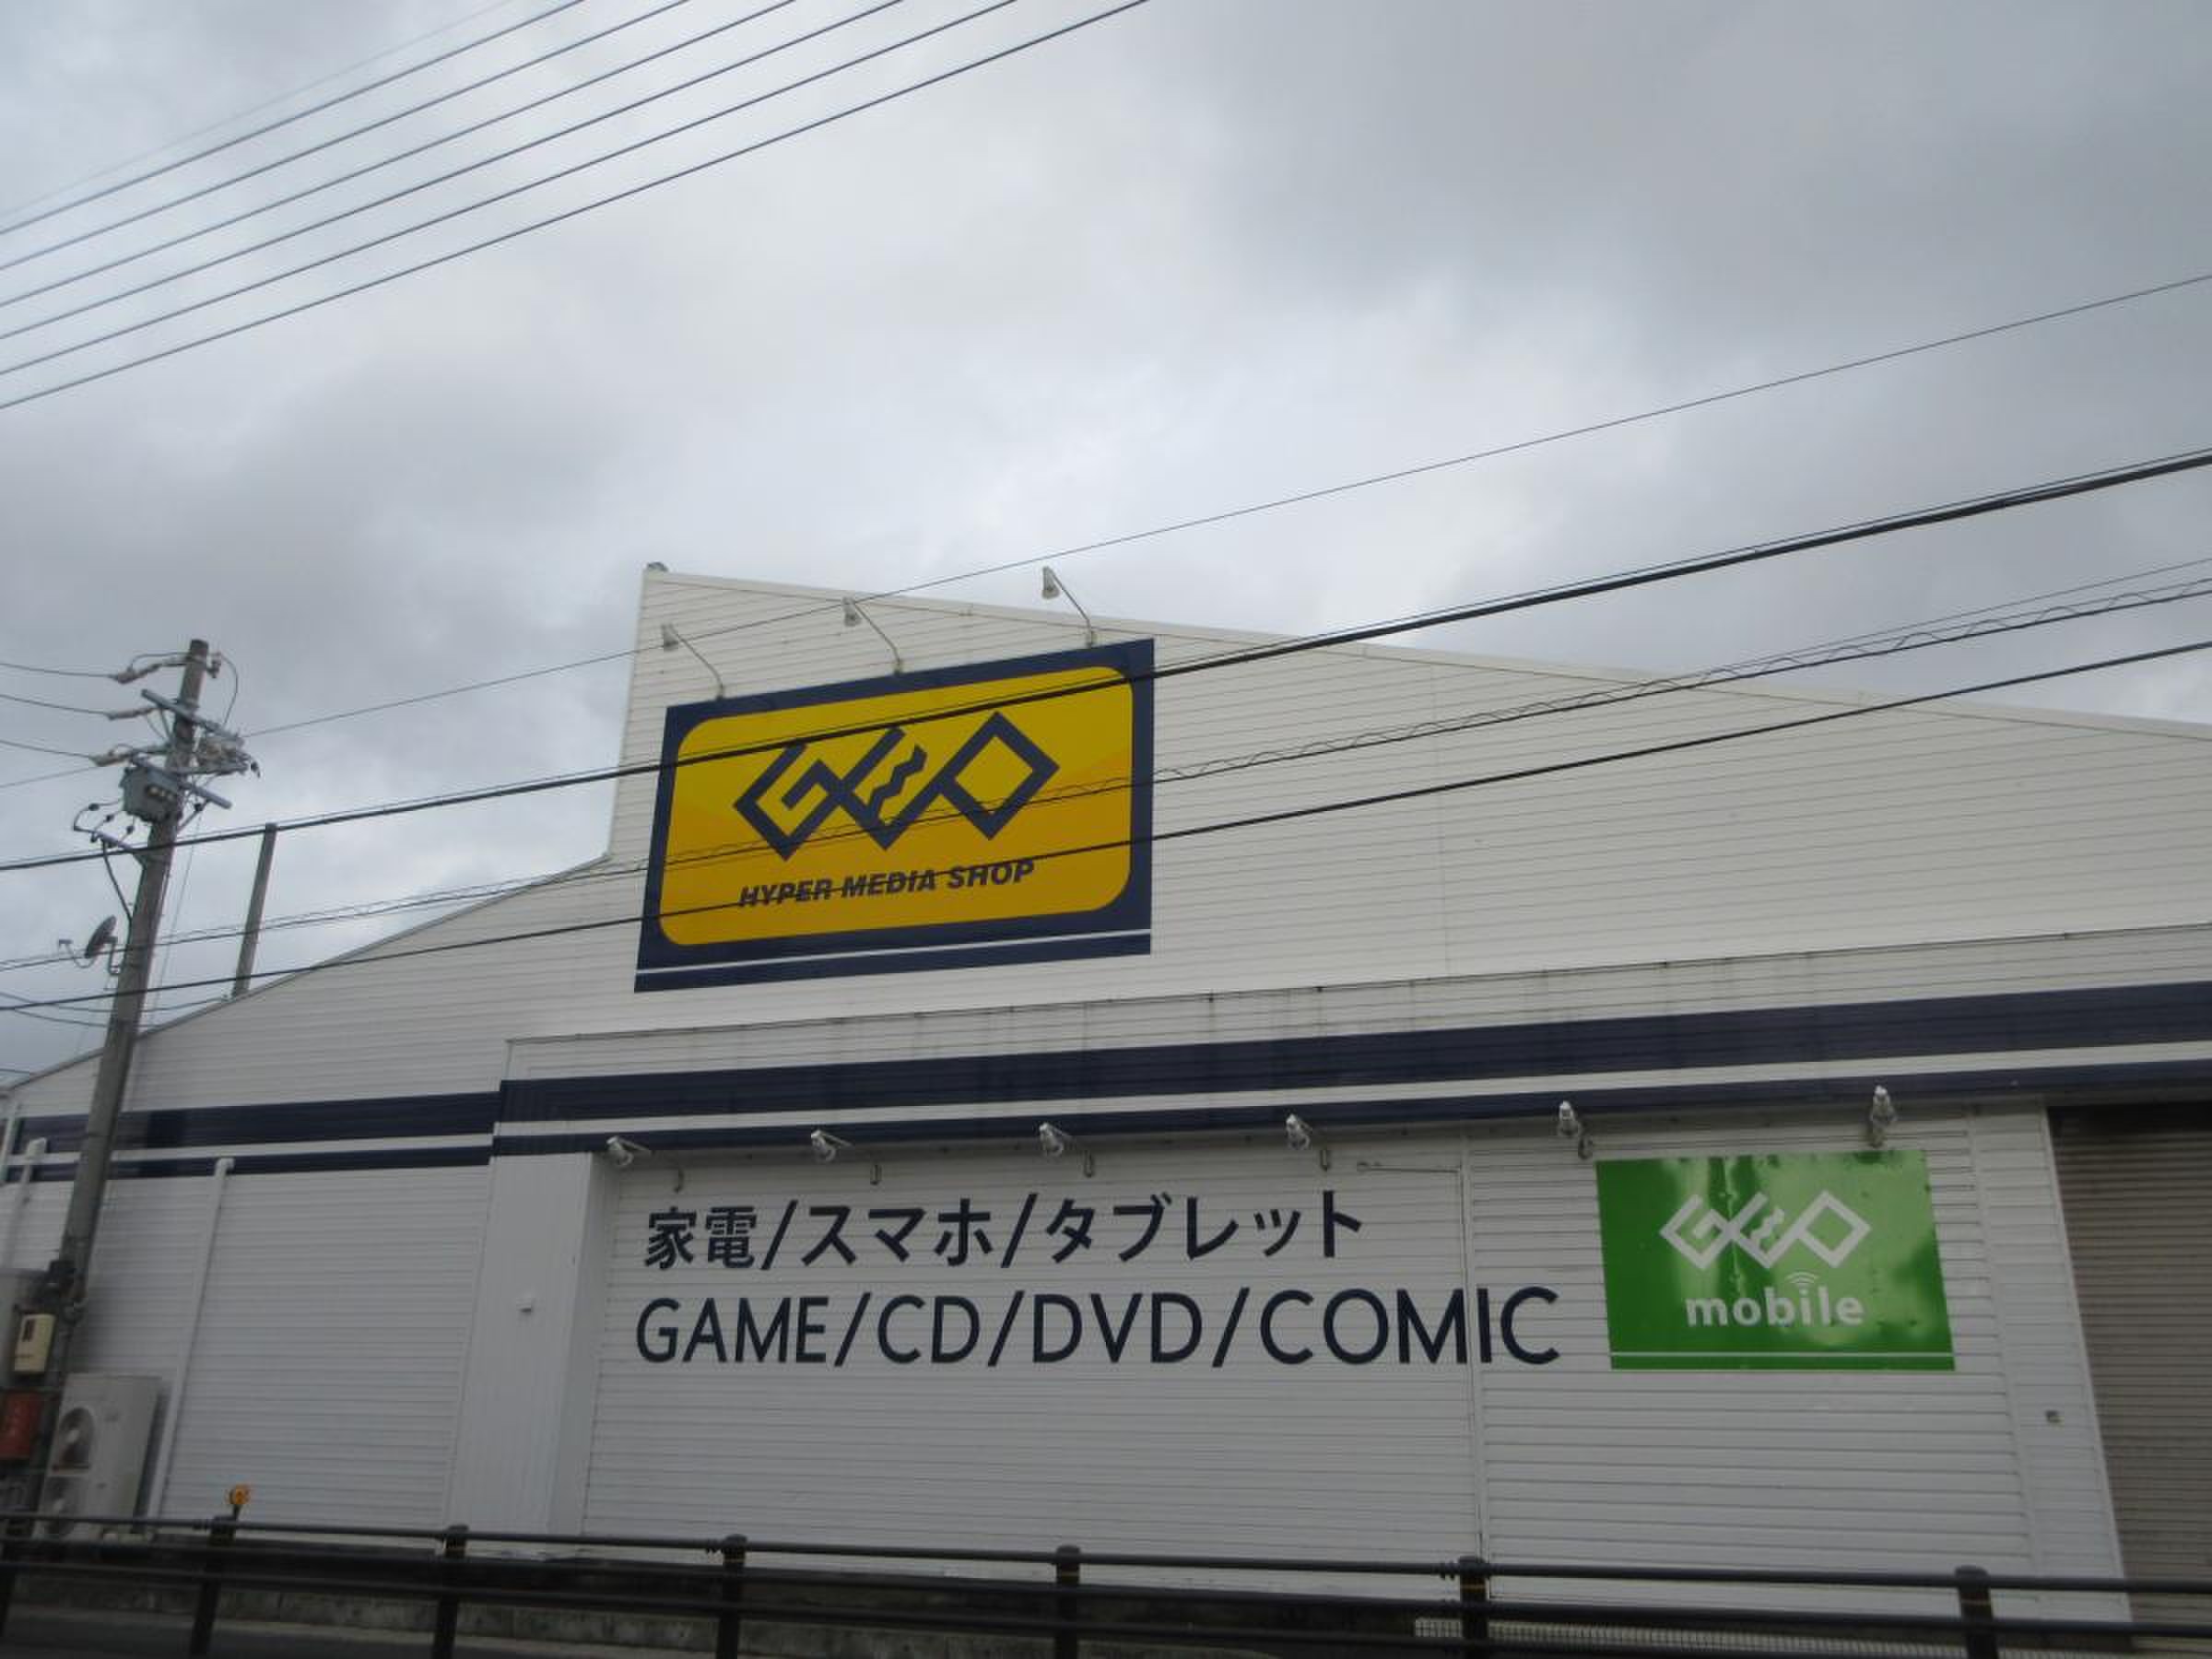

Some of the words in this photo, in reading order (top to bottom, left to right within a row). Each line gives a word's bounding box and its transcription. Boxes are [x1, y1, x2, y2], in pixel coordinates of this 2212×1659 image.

[735, 712, 1059, 861] GEO
[739, 878, 832, 908] HYPER
[841, 869, 936, 898] MEDIA
[947, 863, 1034, 889] SHOP
[1660, 1191, 1871, 1269] GEO
[1685, 1287, 1865, 1326] mobile
